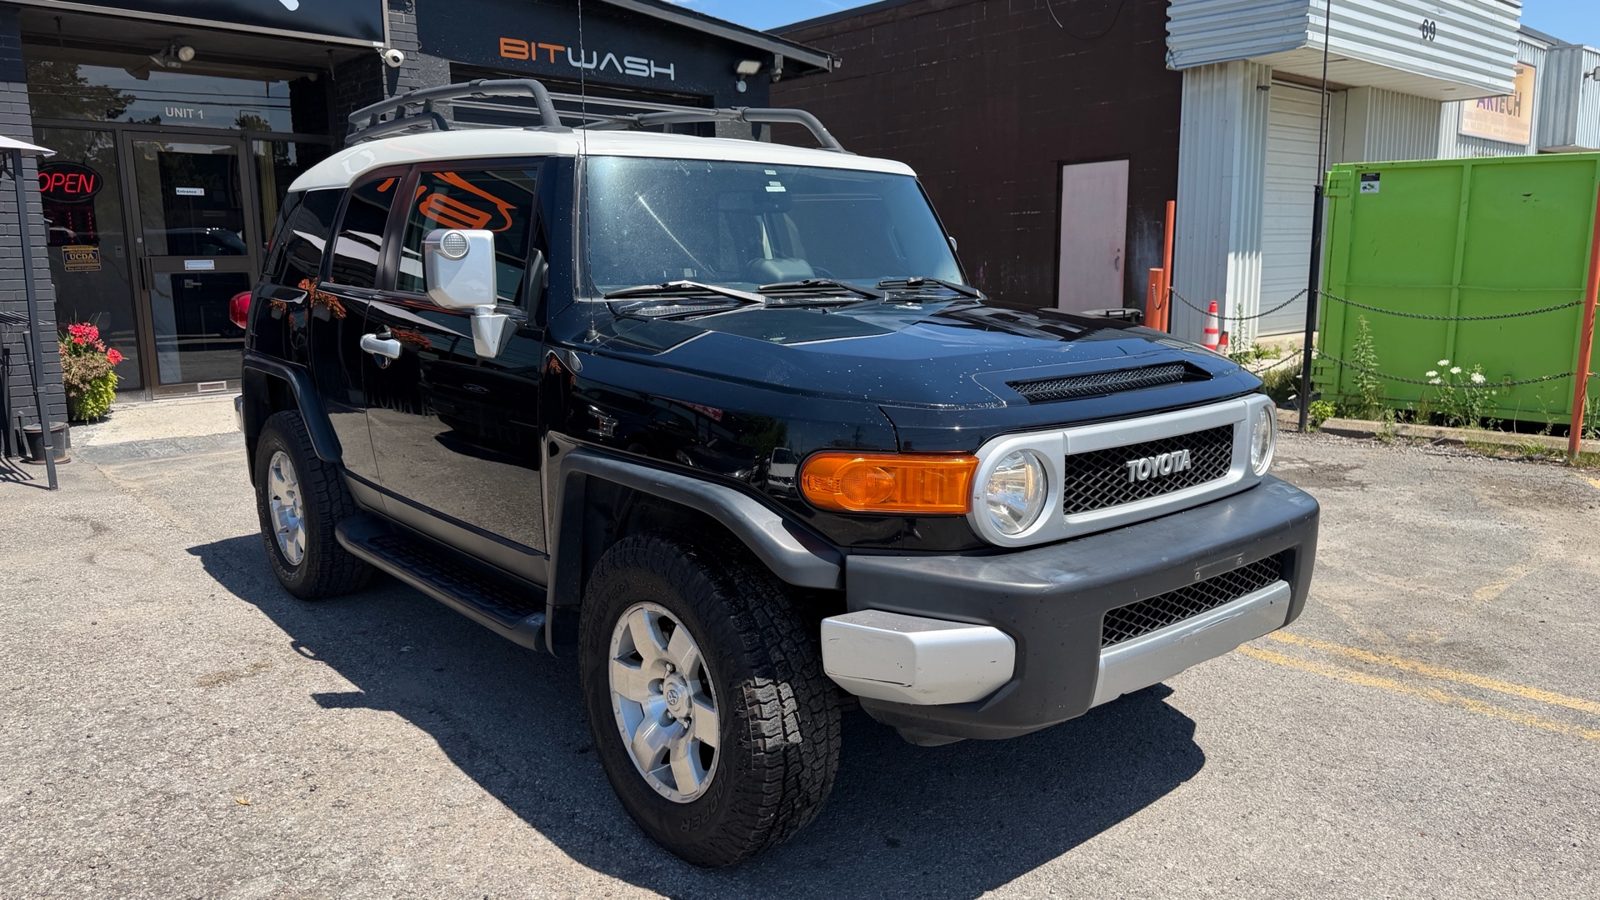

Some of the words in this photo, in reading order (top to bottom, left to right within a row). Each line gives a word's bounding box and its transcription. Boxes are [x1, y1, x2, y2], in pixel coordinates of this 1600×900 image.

[1421, 18, 1436, 42] 69
[499, 37, 676, 82] BITWASH
[165, 106, 194, 118] UNIT
[197, 109, 204, 120] 1
[37, 172, 95, 193] OPEN
[1126, 448, 1192, 483] TOYOTA
